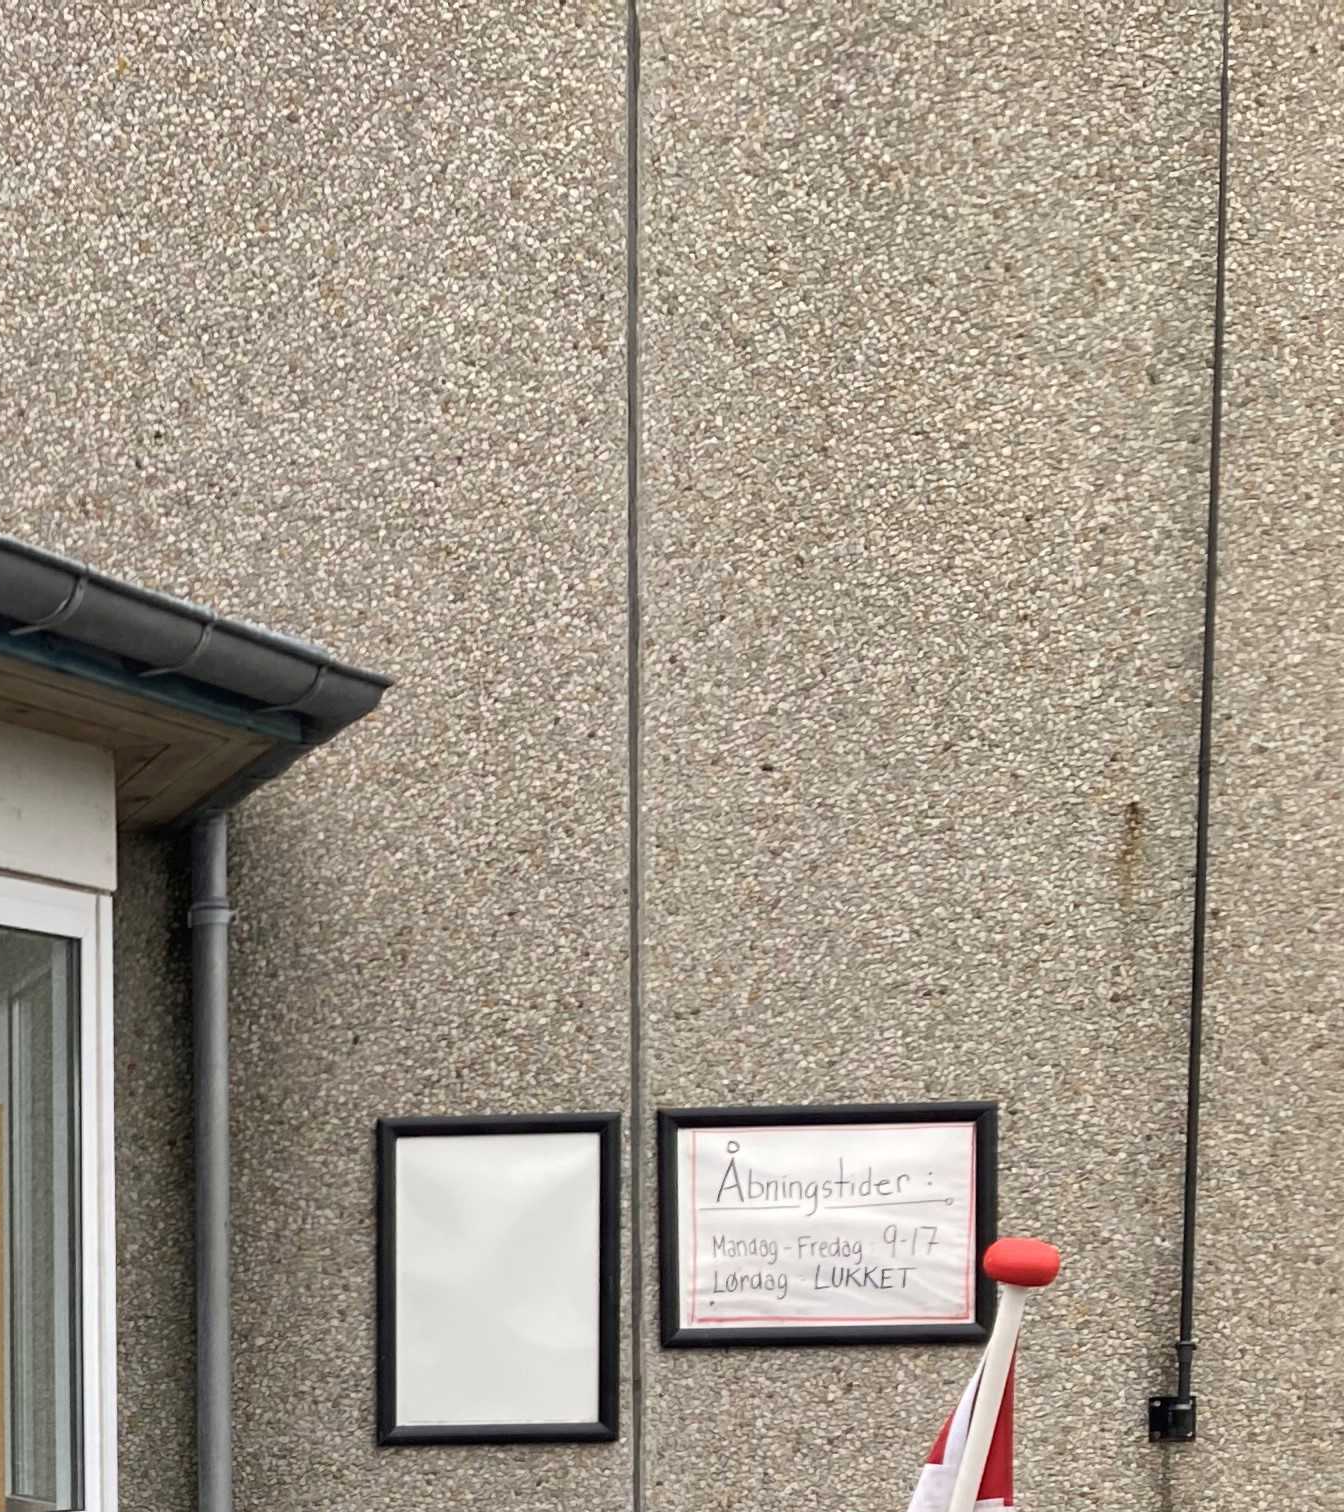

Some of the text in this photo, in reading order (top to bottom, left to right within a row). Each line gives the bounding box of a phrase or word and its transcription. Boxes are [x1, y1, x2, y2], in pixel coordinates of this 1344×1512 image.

[882, 1224, 940, 1259] 9-17
[713, 1263, 918, 1300] Lørdag LUKKET
